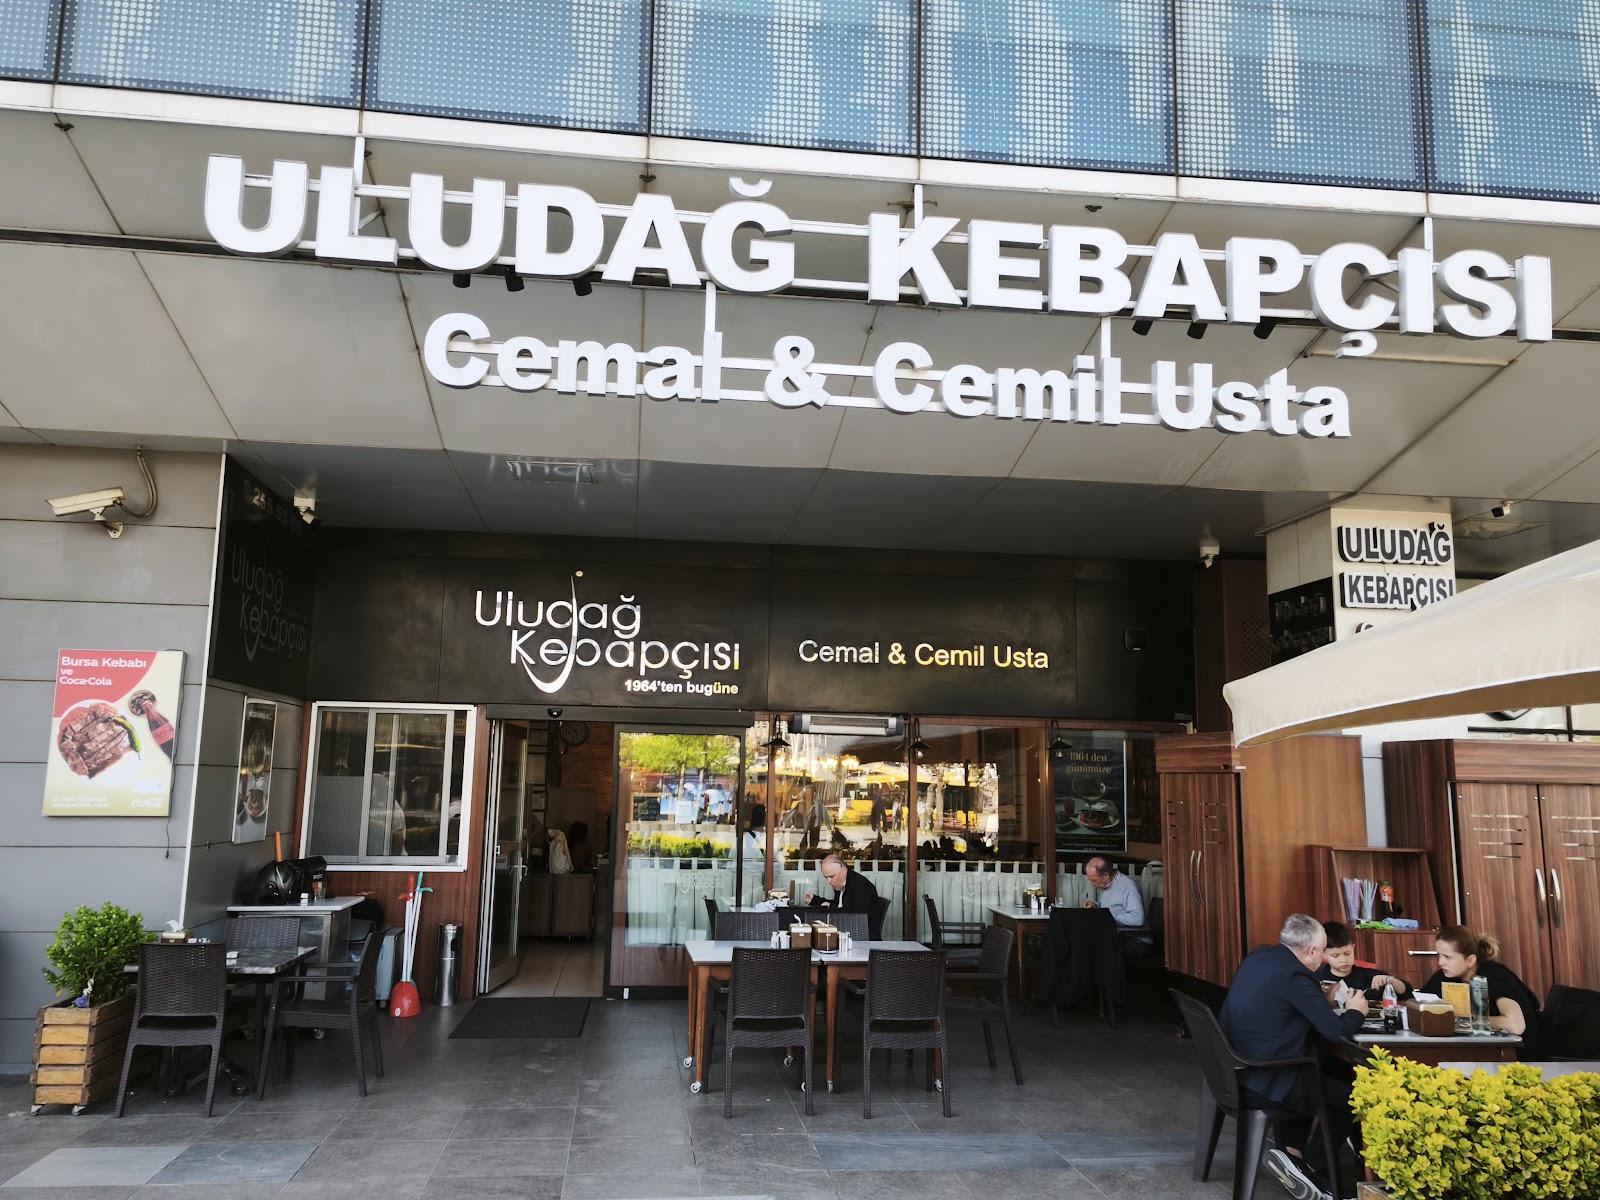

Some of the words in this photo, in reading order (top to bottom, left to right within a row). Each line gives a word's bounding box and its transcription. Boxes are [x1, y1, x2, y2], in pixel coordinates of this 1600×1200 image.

[204, 153, 796, 295] ULUDAĞ
[867, 211, 1553, 359] KEBAPÇISI
[423, 312, 723, 404] Cemal
[763, 335, 831, 409] &
[873, 341, 1122, 427] Cemil
[1151, 360, 1352, 440] Usta
[1341, 522, 1453, 564] ULUDAĞ
[475, 577, 641, 639] Uludağ
[61, 656, 99, 667] Bursa
[102, 657, 147, 668] Kebabı
[509, 629, 740, 682] Kebapçısı
[798, 639, 880, 664] Cemal
[887, 642, 907, 666] &
[913, 643, 985, 668] Cemil
[992, 646, 1050, 669] Usta
[59, 676, 112, 686] Coca-Cola
[60, 668, 74, 676] ve
[624, 678, 683, 694] 1964'ten
[686, 680, 739, 697] bugüne
[1091, 752, 1107, 762] den
